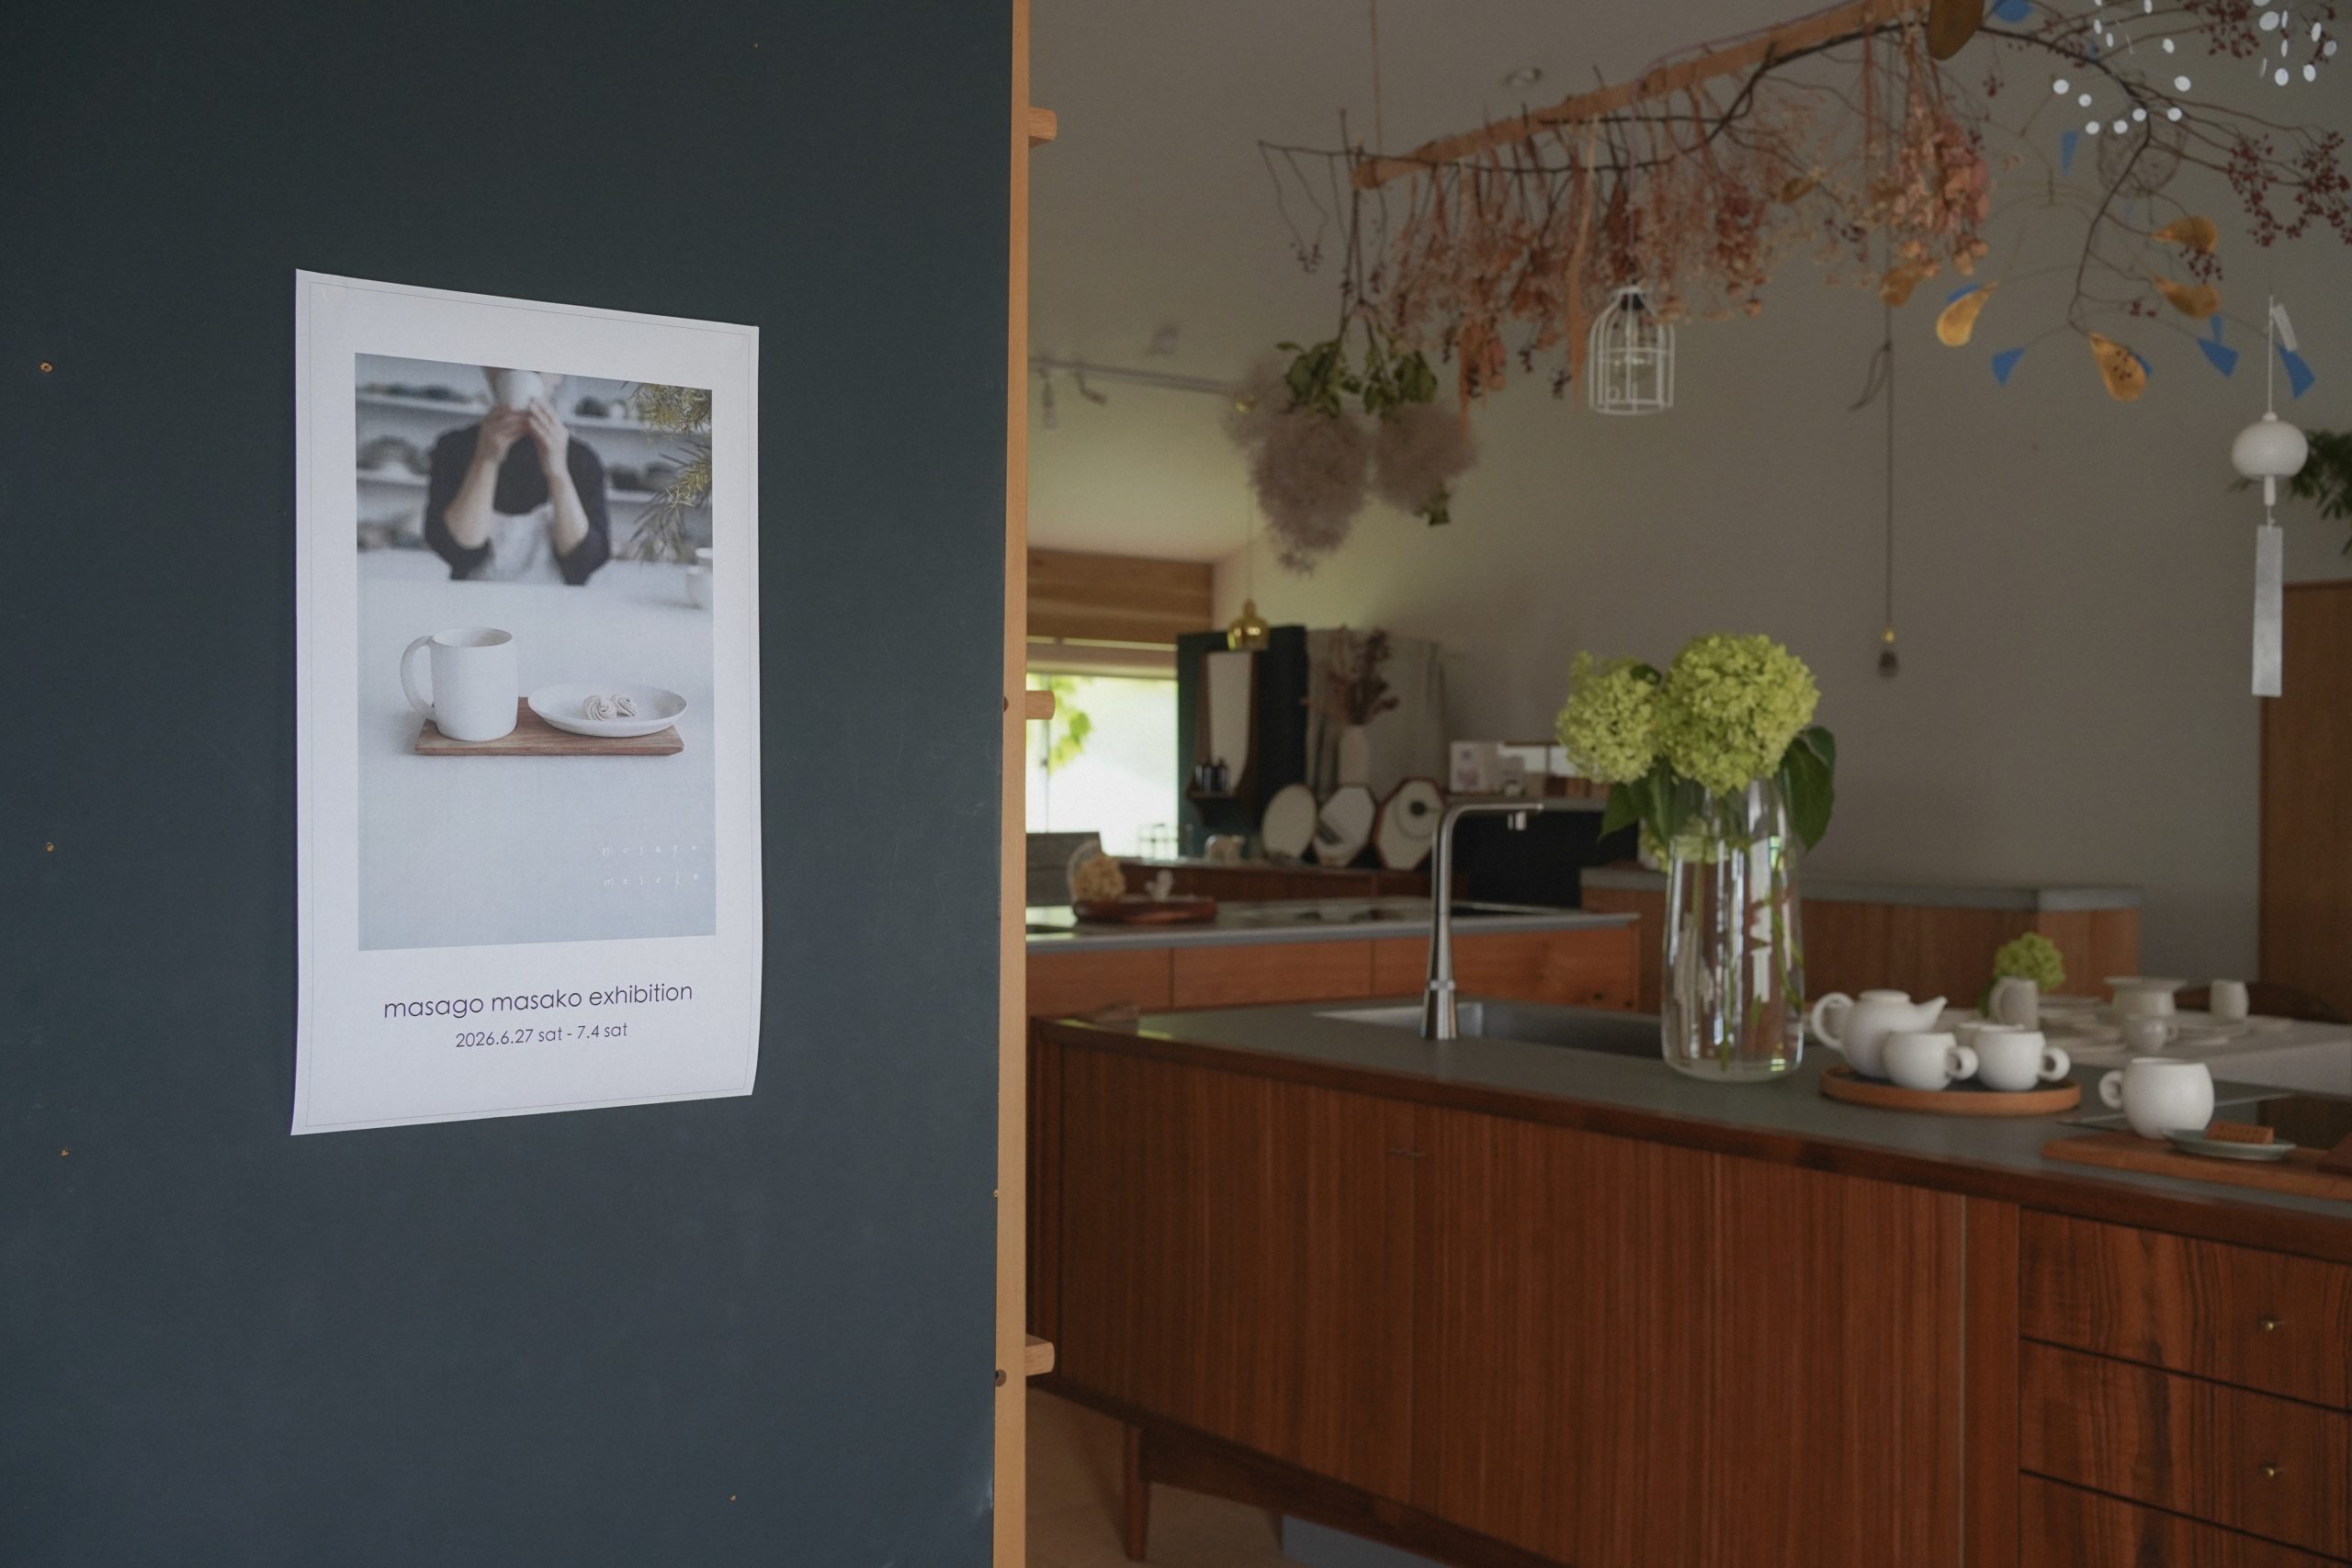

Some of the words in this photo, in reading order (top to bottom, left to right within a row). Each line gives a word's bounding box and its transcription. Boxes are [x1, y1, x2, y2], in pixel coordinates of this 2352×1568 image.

[384, 998, 484, 1019] masago
[492, 988, 582, 1012] masako
[588, 983, 693, 1007] exhibition
[455, 1028, 534, 1048] 2026.6.27
[537, 1026, 563, 1043] sat
[577, 1024, 600, 1040] 7.4
[604, 1021, 628, 1038] sat
